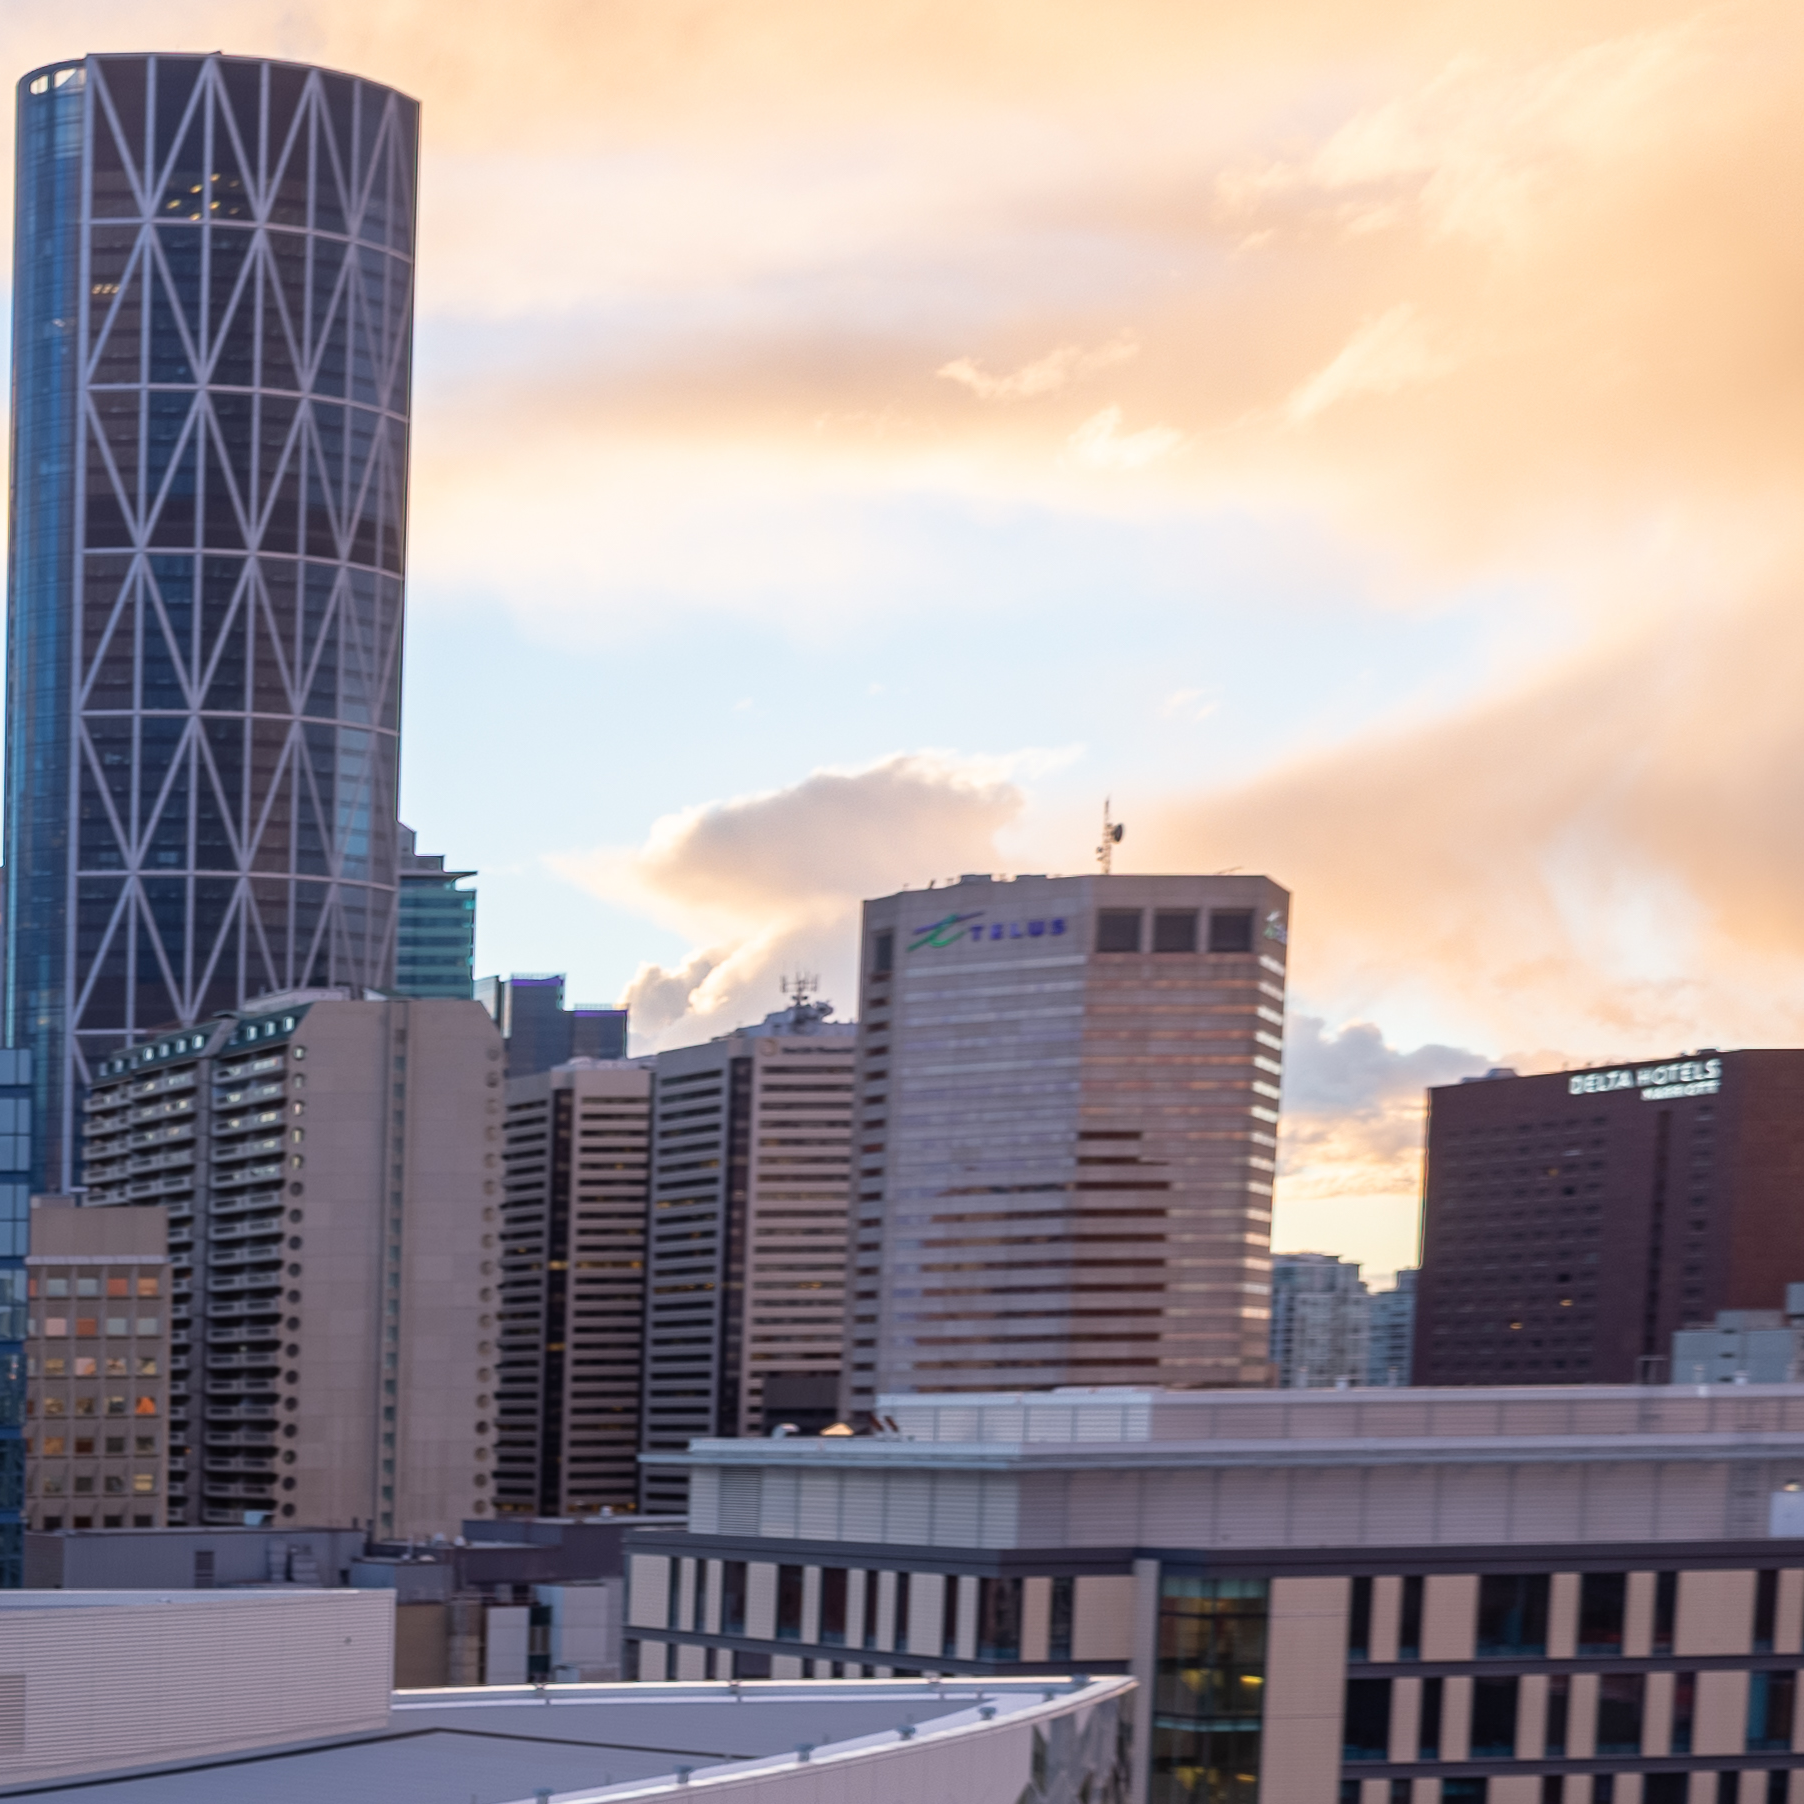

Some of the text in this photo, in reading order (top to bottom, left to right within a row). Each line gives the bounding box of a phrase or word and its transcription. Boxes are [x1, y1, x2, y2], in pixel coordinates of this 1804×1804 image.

[970, 917, 1067, 942] TELUS
[1568, 1058, 1722, 1095] DELTA HOTELS
